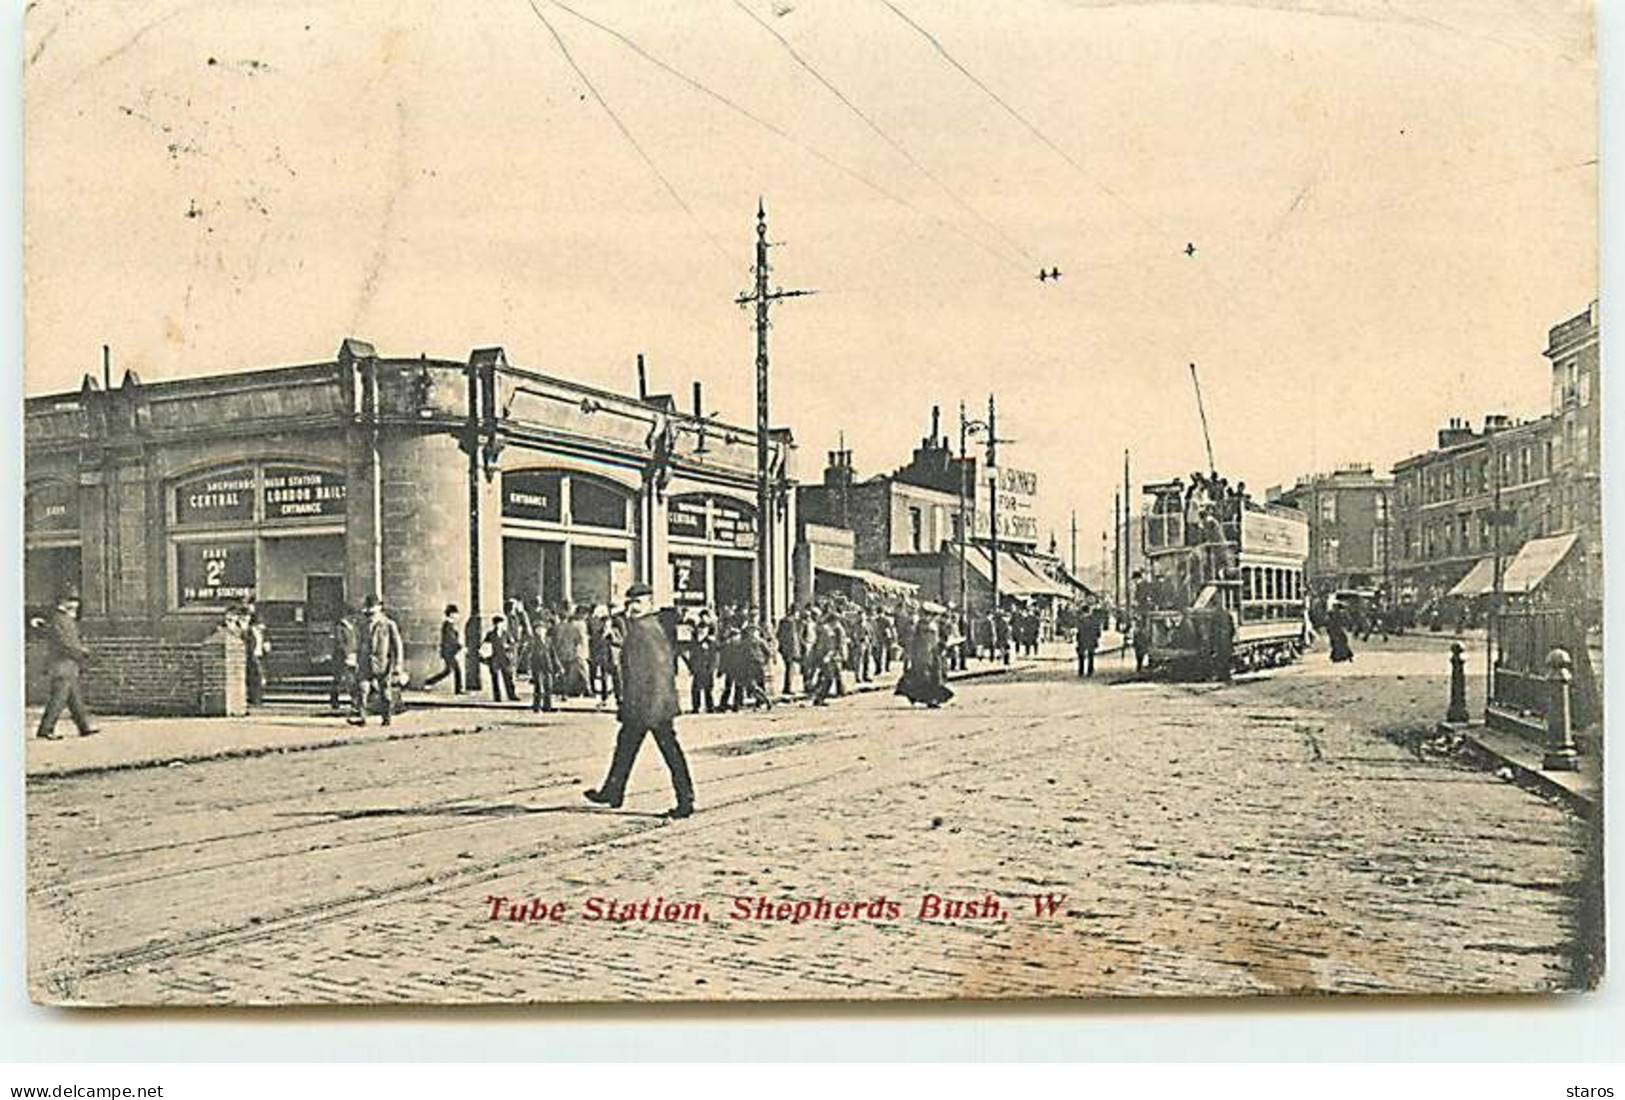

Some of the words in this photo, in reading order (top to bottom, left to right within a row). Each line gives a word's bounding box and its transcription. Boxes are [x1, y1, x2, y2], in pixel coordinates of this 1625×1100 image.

[190, 493, 239, 508] CENTRAL
[267, 488, 311, 503] LONDON
[281, 502, 322, 515] ENTRANCE
[202, 549, 227, 560] FARE
[184, 588, 196, 599] TO
[198, 588, 215, 598] ANY
